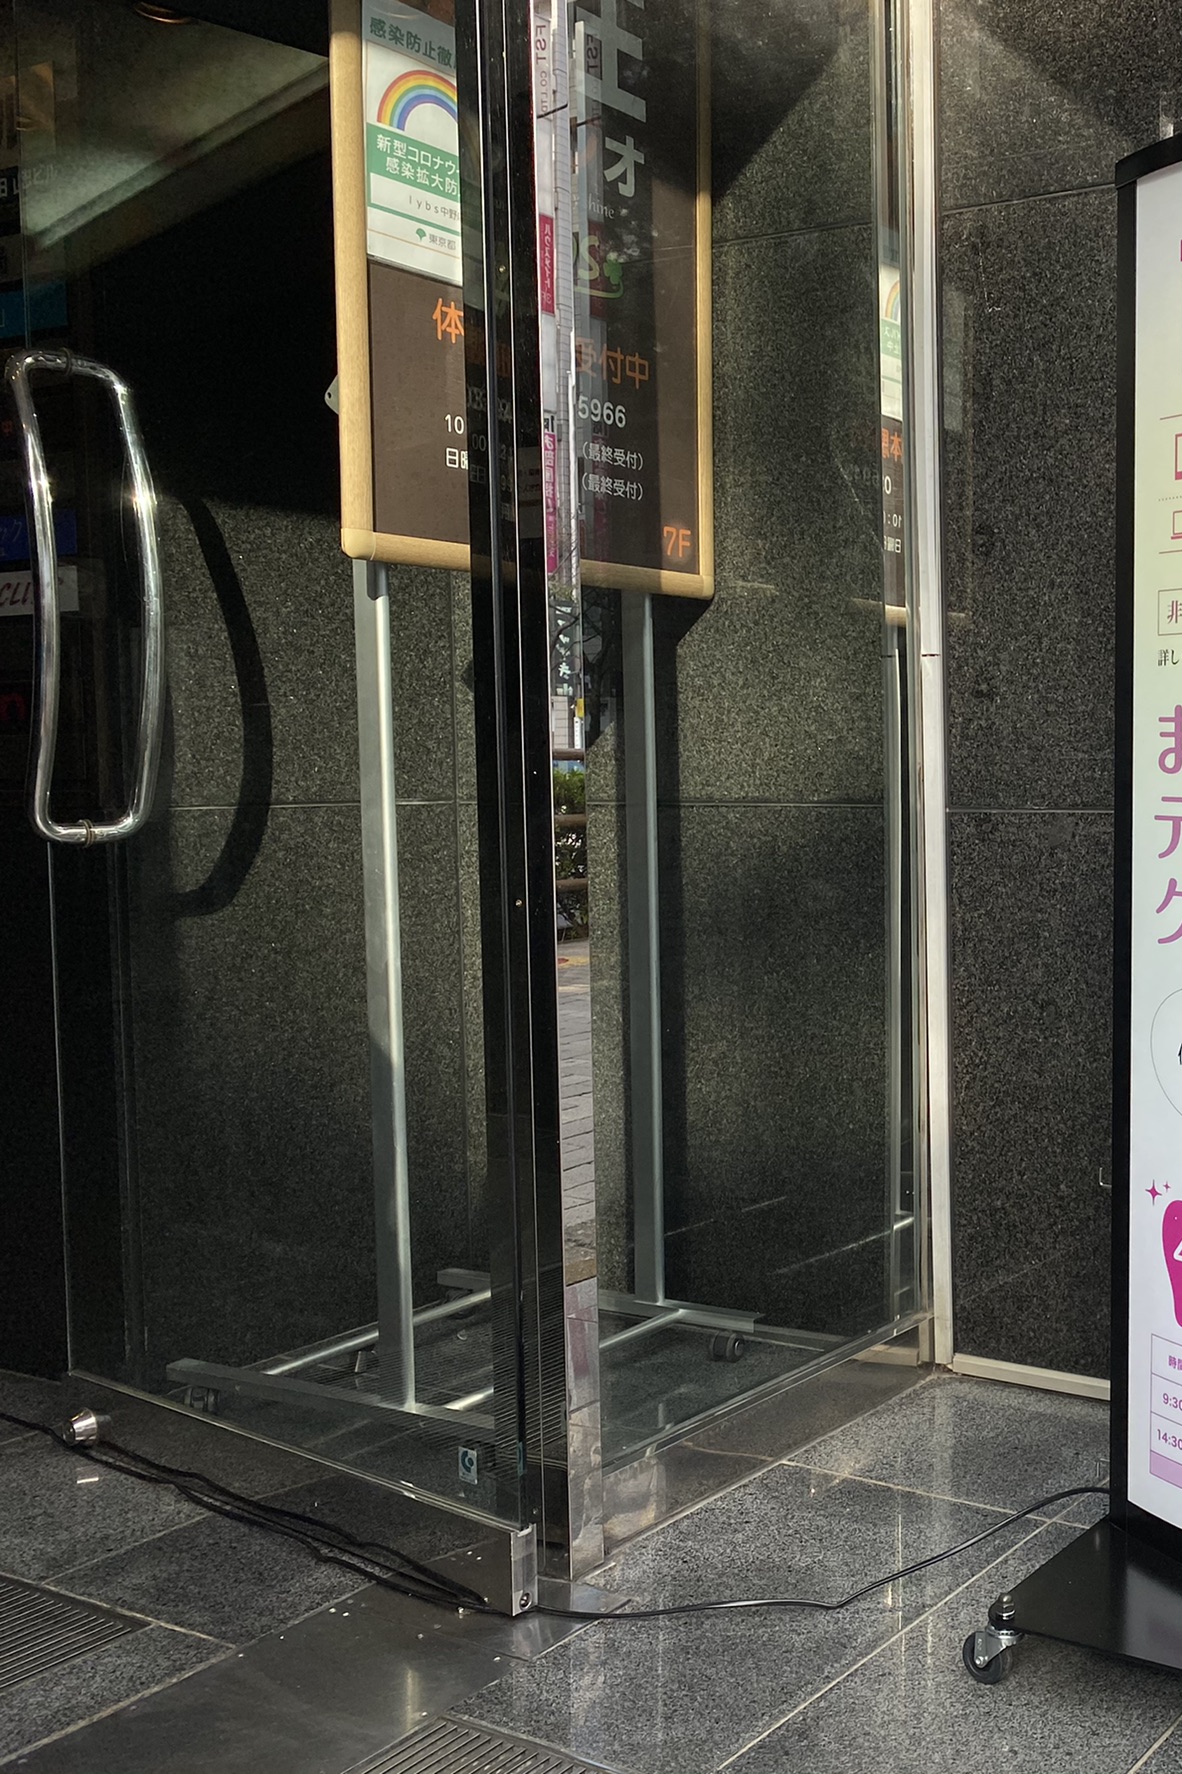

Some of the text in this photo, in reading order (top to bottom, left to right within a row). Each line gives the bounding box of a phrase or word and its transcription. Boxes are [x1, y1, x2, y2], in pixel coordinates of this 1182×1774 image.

[369, 16, 456, 69] 感染防止徹
[376, 134, 460, 175] 新型コロナウ
[386, 156, 460, 197] 感染拡大防
[428, 233, 457, 251] 東京都
[577, 395, 627, 429] 5966
[582, 441, 644, 471] (最終受付)
[581, 472, 644, 501] (最終受付)
[663, 525, 692, 558] 7F
